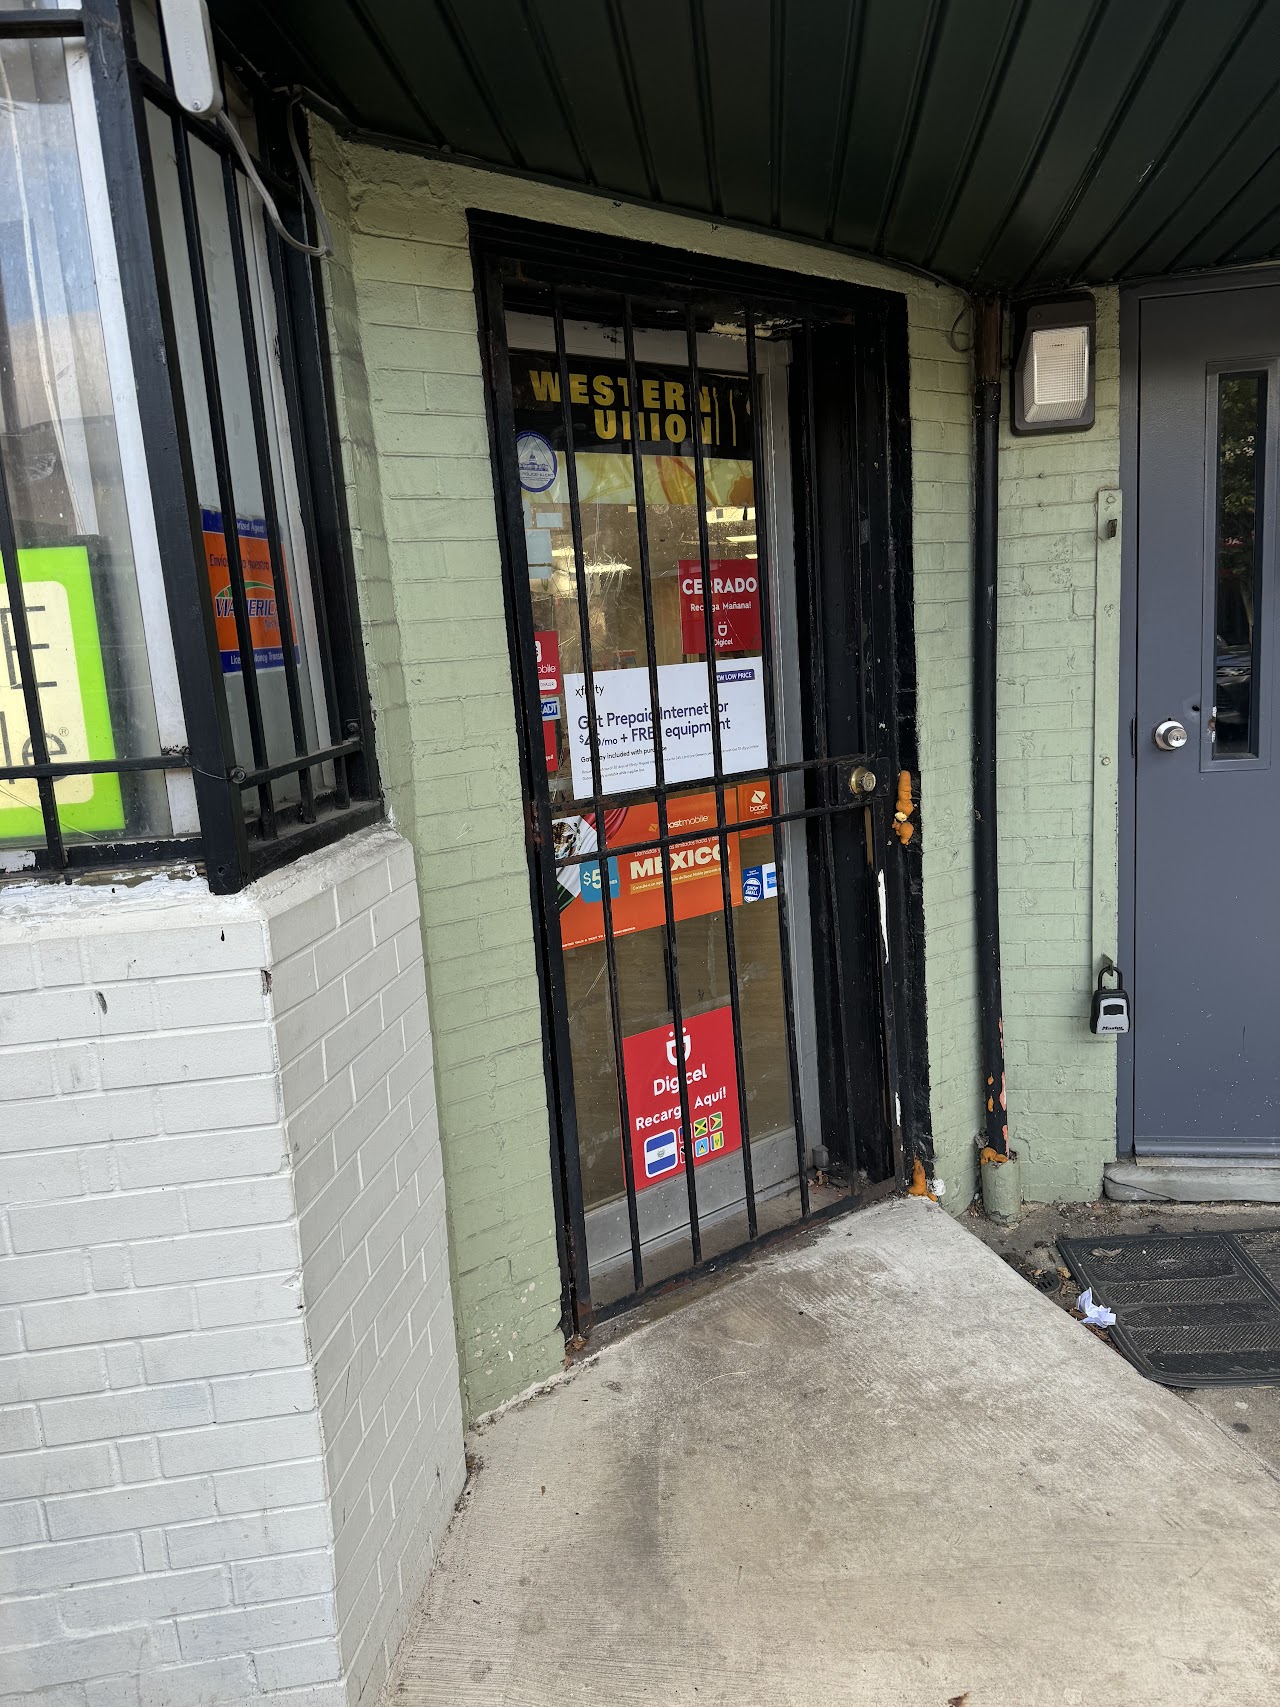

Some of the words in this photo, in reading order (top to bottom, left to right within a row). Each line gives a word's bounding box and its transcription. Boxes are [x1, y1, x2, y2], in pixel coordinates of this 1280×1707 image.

[210, 553, 228, 568] Envío
[682, 577, 757, 595] CERADO
[690, 603, 720, 613] Recga
[722, 601, 752, 610] Mañana!
[538, 663, 556, 674] obile
[726, 673, 738, 681] LOW
[738, 672, 752, 680] PRICE
[575, 684, 604, 698] xfty
[578, 714, 604, 730] Gt
[660, 702, 709, 720] Internet
[718, 702, 729, 713] or
[620, 734, 628, 743] +
[632, 727, 654, 742] FRE
[665, 718, 731, 740] equipmnt
[606, 750, 630, 759] included
[630, 748, 643, 756] with
[750, 804, 769, 813] boost
[667, 815, 708, 829] ostmobile
[654, 1063, 708, 1096] Digcel
[636, 1106, 682, 1131] Recarg
[694, 1086, 727, 1110] Aquí!
